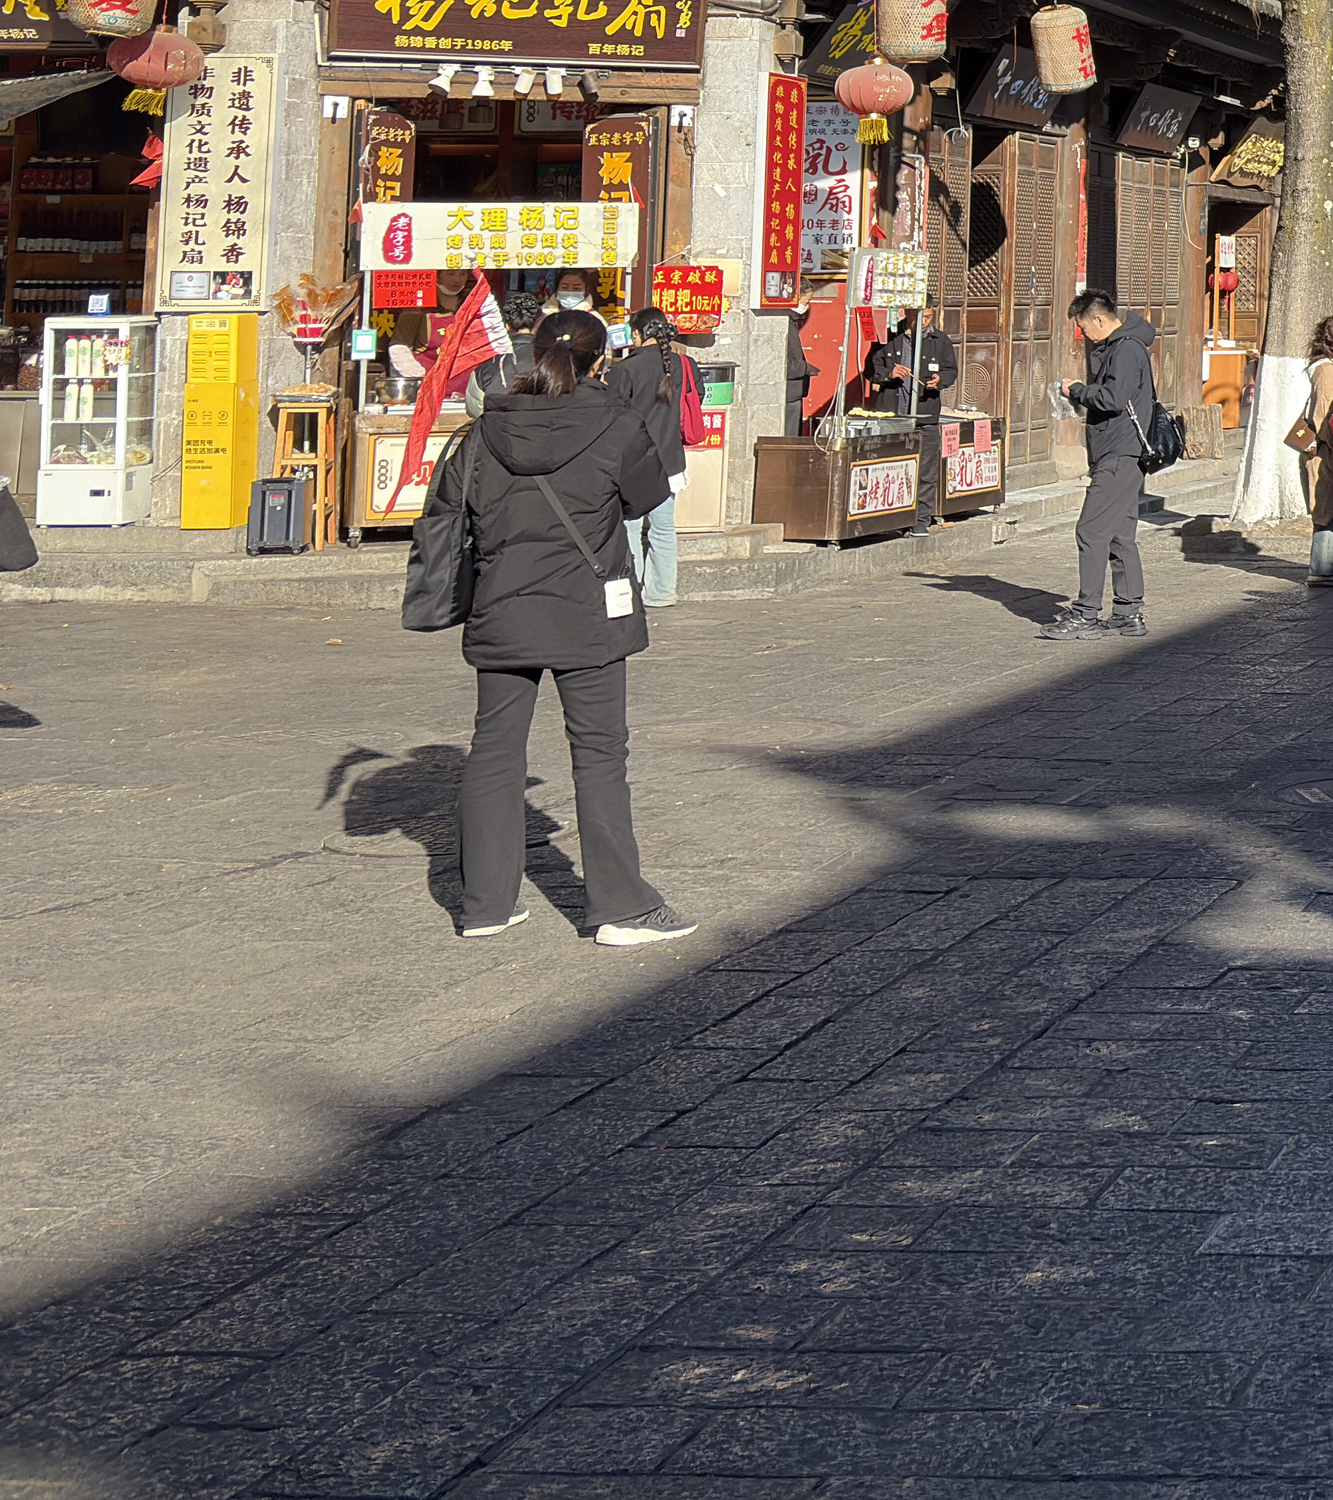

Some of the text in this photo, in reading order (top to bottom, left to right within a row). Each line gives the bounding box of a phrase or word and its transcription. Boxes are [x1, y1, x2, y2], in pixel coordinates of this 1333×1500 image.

[394, 35, 513, 51] 杨锦香创于1986年
[588, 43, 645, 56] 百年杨记
[588, 132, 645, 146] 正宗老字号
[178, 66, 216, 265] 非物质文化遗产杨记乳扇
[219, 66, 256, 264] 非遗传承人 杨锦香
[375, 146, 404, 202] 杨记
[769, 85, 785, 265] 非物质文化遗产杨记乳扇
[784, 88, 799, 264] 非遗传承人 杨锦香
[388, 216, 411, 261] 老字号
[447, 206, 579, 231] 大理杨记
[601, 206, 618, 265] 当日现烤
[447, 234, 506, 249] 烤乳扇
[653, 270, 718, 285] 正宗破酥
